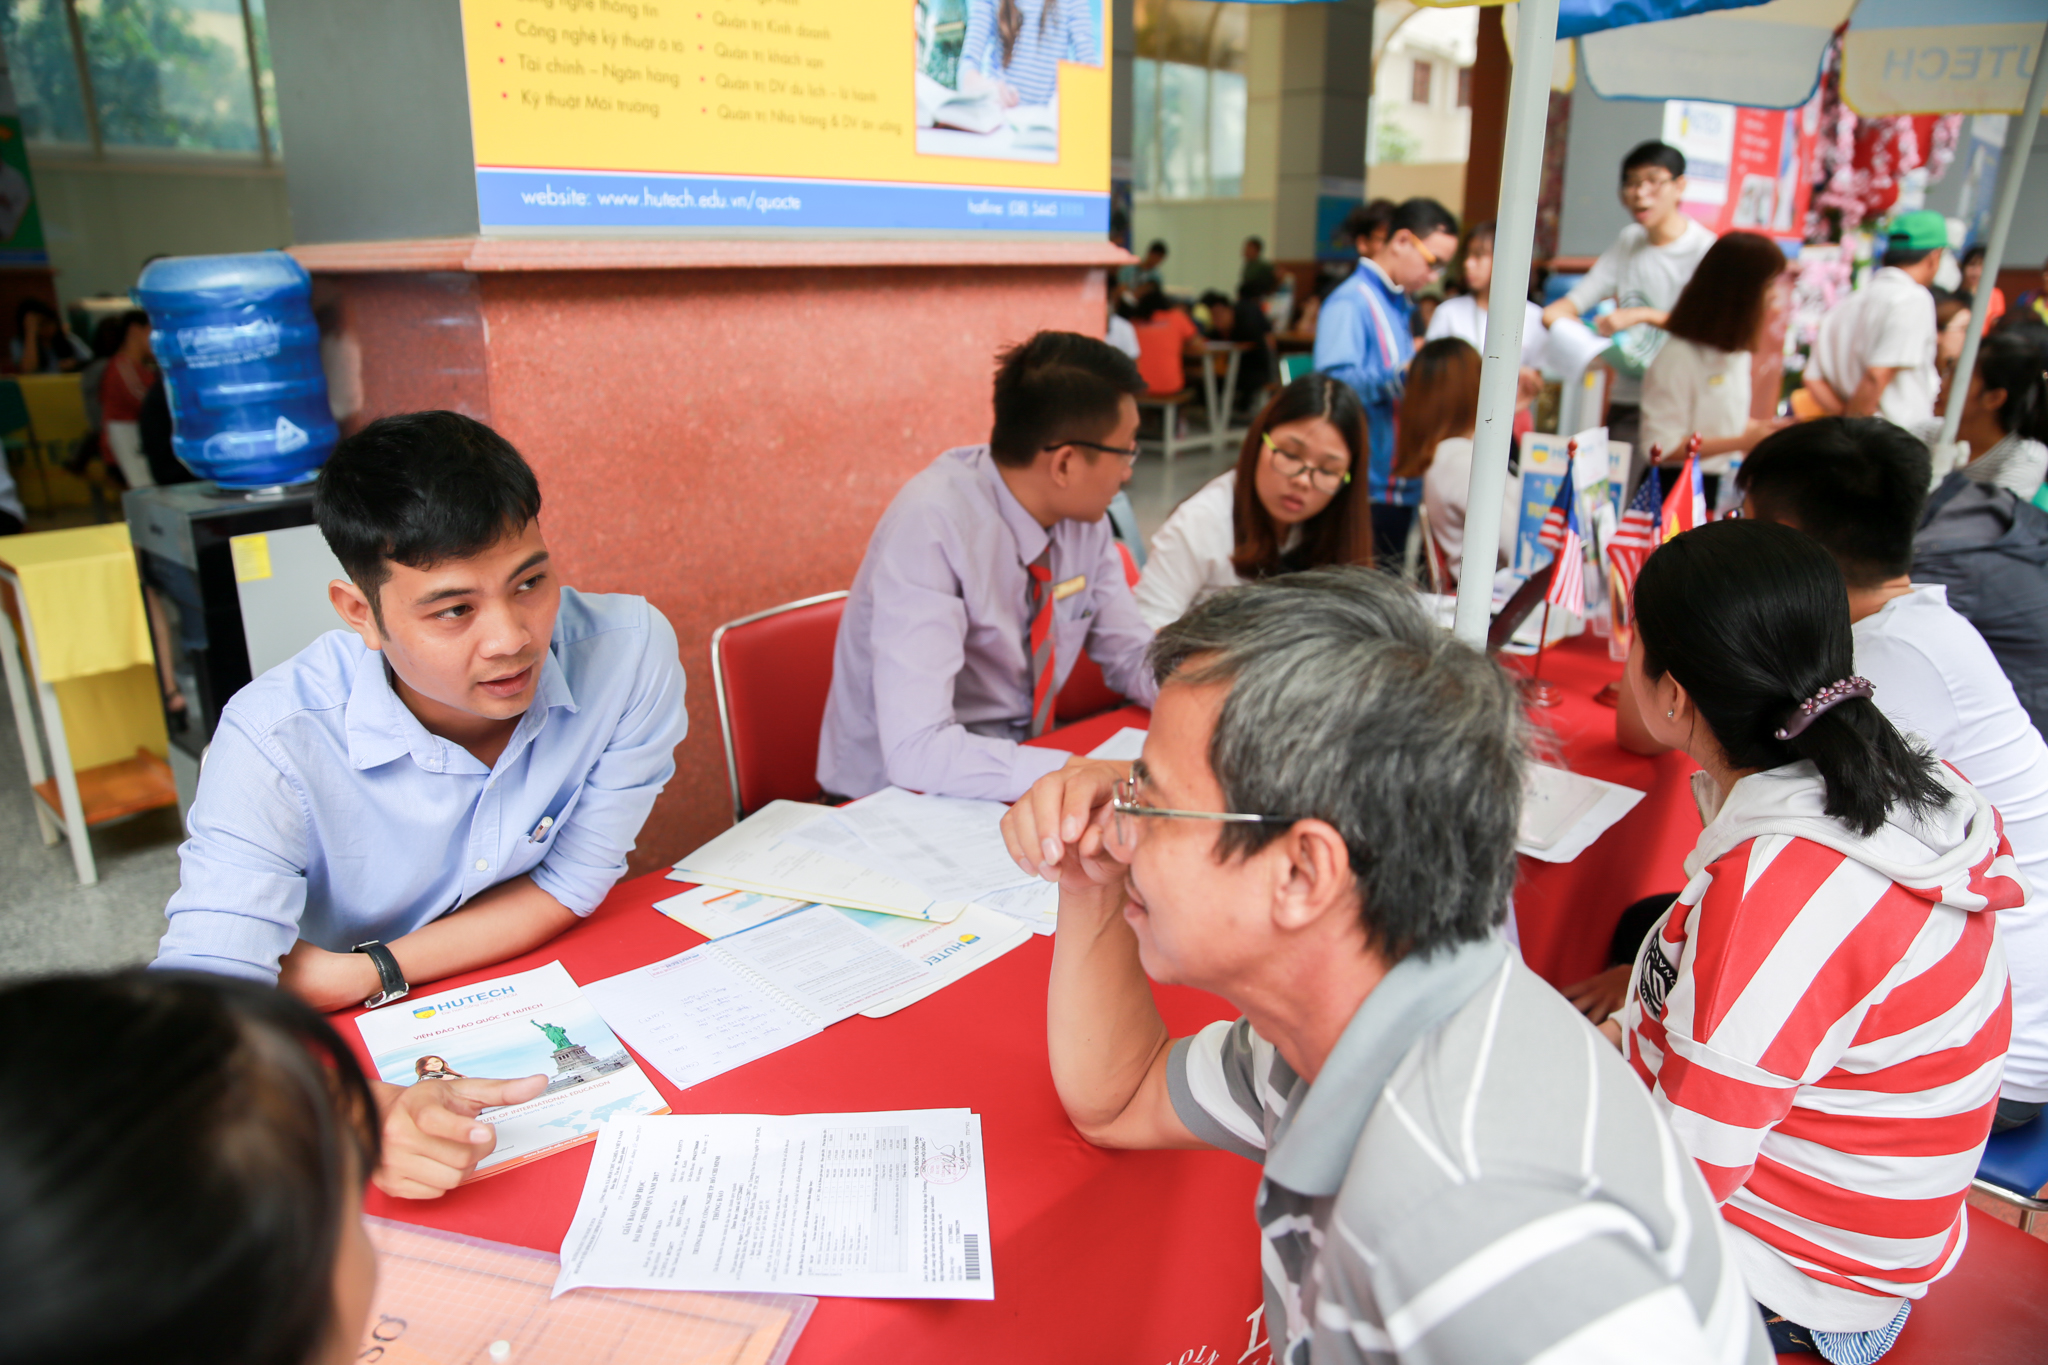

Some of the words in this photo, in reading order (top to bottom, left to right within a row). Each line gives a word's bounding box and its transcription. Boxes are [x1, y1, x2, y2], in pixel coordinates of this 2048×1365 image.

[521, 184, 592, 206] website:
[924, 942, 966, 966] HUTE
[437, 986, 515, 1011] HUTECH
[512, 1003, 544, 1015] HUTECH
[499, 1111, 509, 1119] OF
[511, 1093, 569, 1115] INTERNATIONAL
[569, 1080, 611, 1096] EDUCATION
